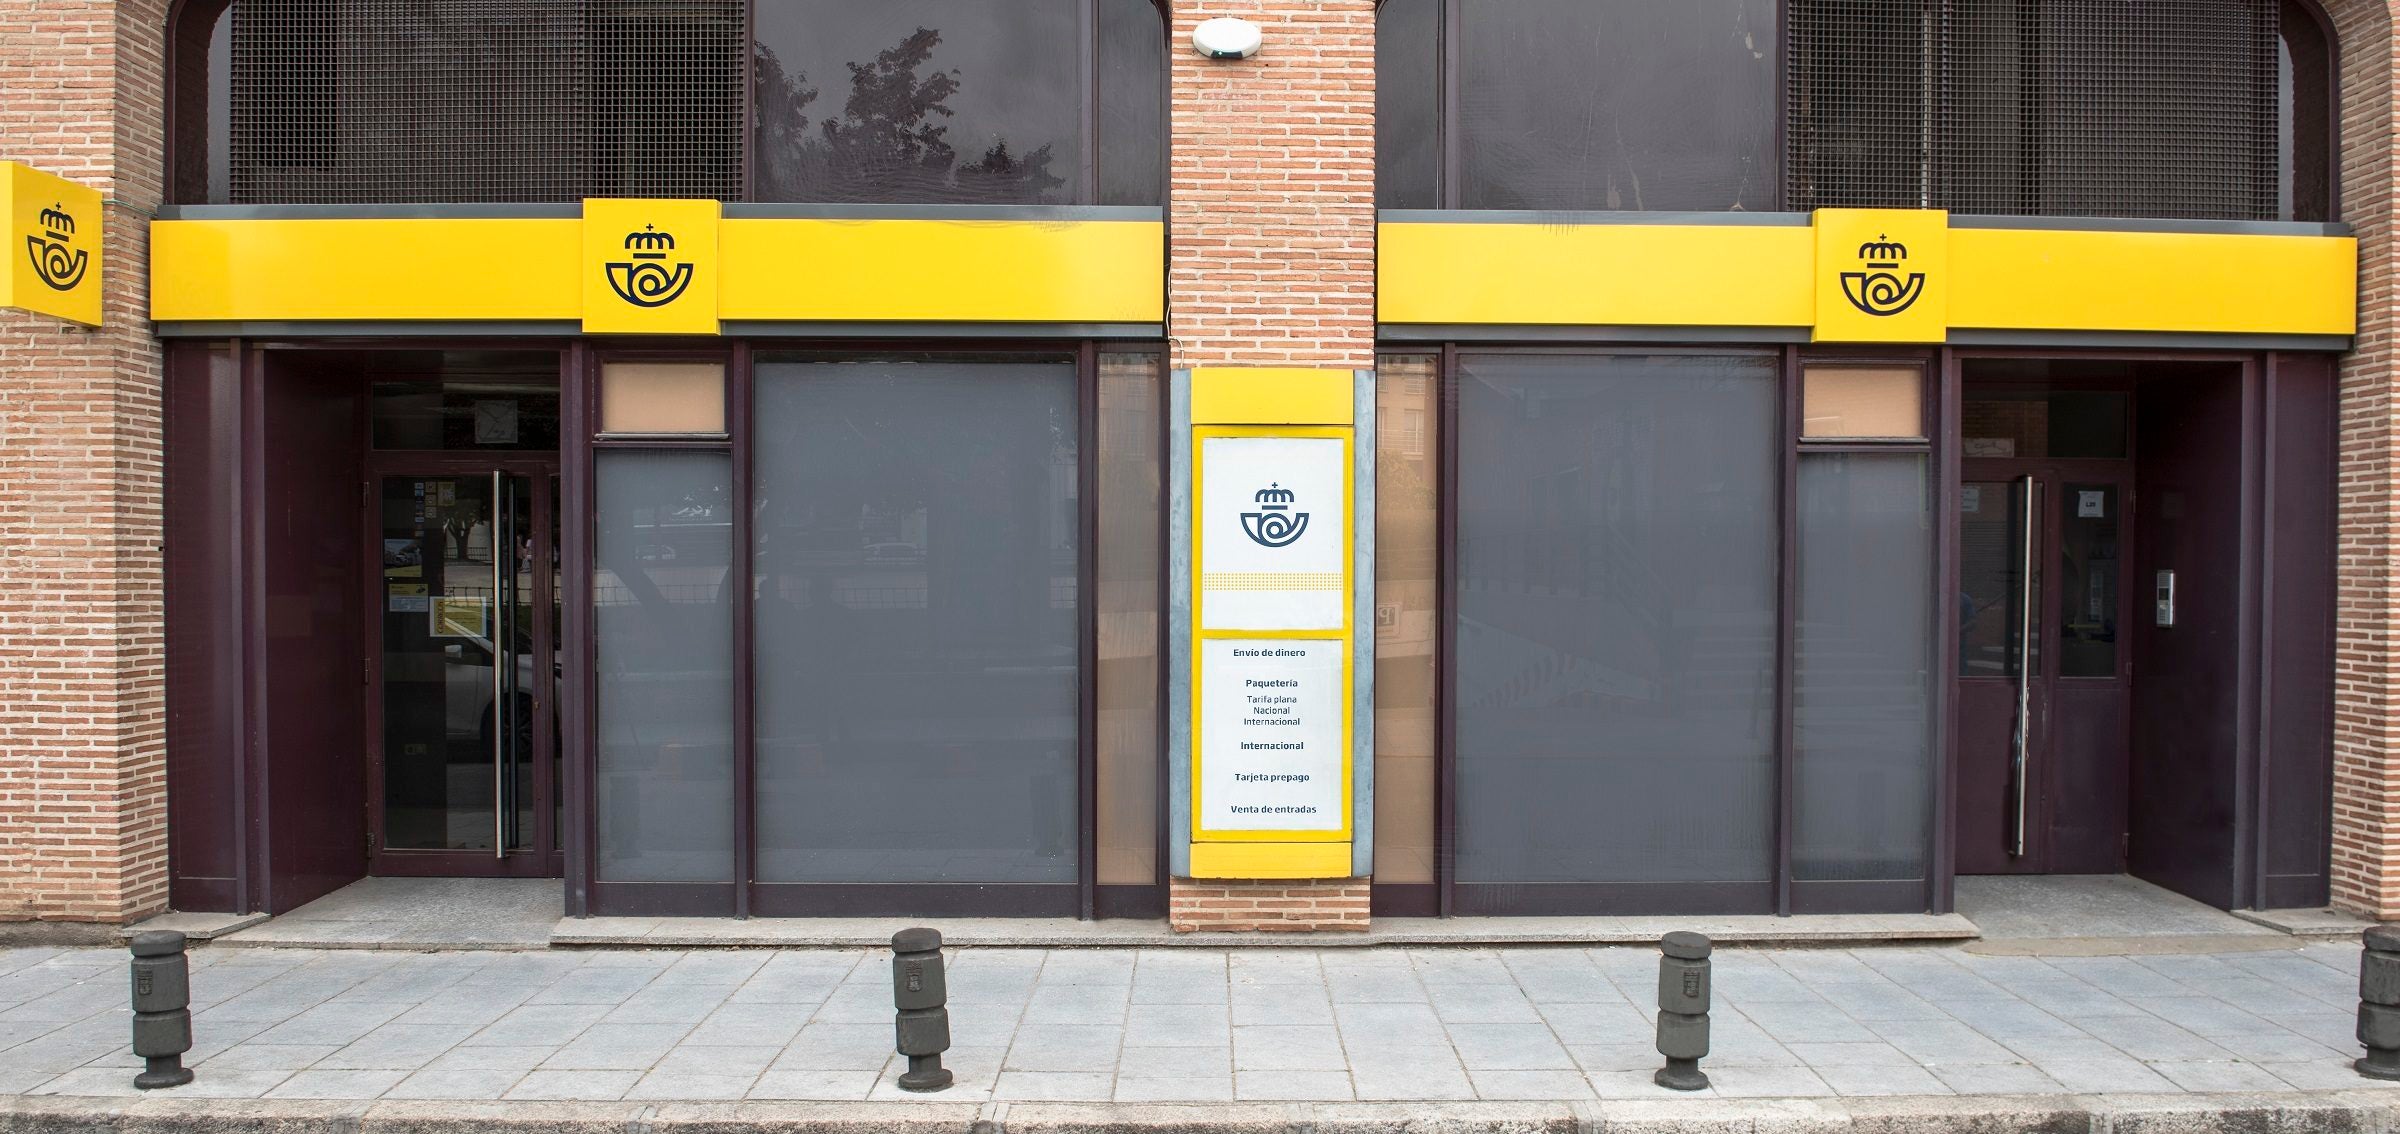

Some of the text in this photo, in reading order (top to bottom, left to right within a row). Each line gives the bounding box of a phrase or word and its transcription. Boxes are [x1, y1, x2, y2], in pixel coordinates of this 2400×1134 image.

[1261, 648, 1274, 657] de
[1275, 648, 1306, 657] dinero
[1245, 679, 1298, 689] Paquetería
[1247, 695, 1297, 705] Tarifa plana
[1253, 706, 1290, 715] Nacional
[1243, 717, 1301, 726] Internacional
[1240, 741, 1304, 750] Internacional
[1234, 772, 1310, 783] Tarjeta prepago
[1230, 805, 1317, 814] Venta de entradas
